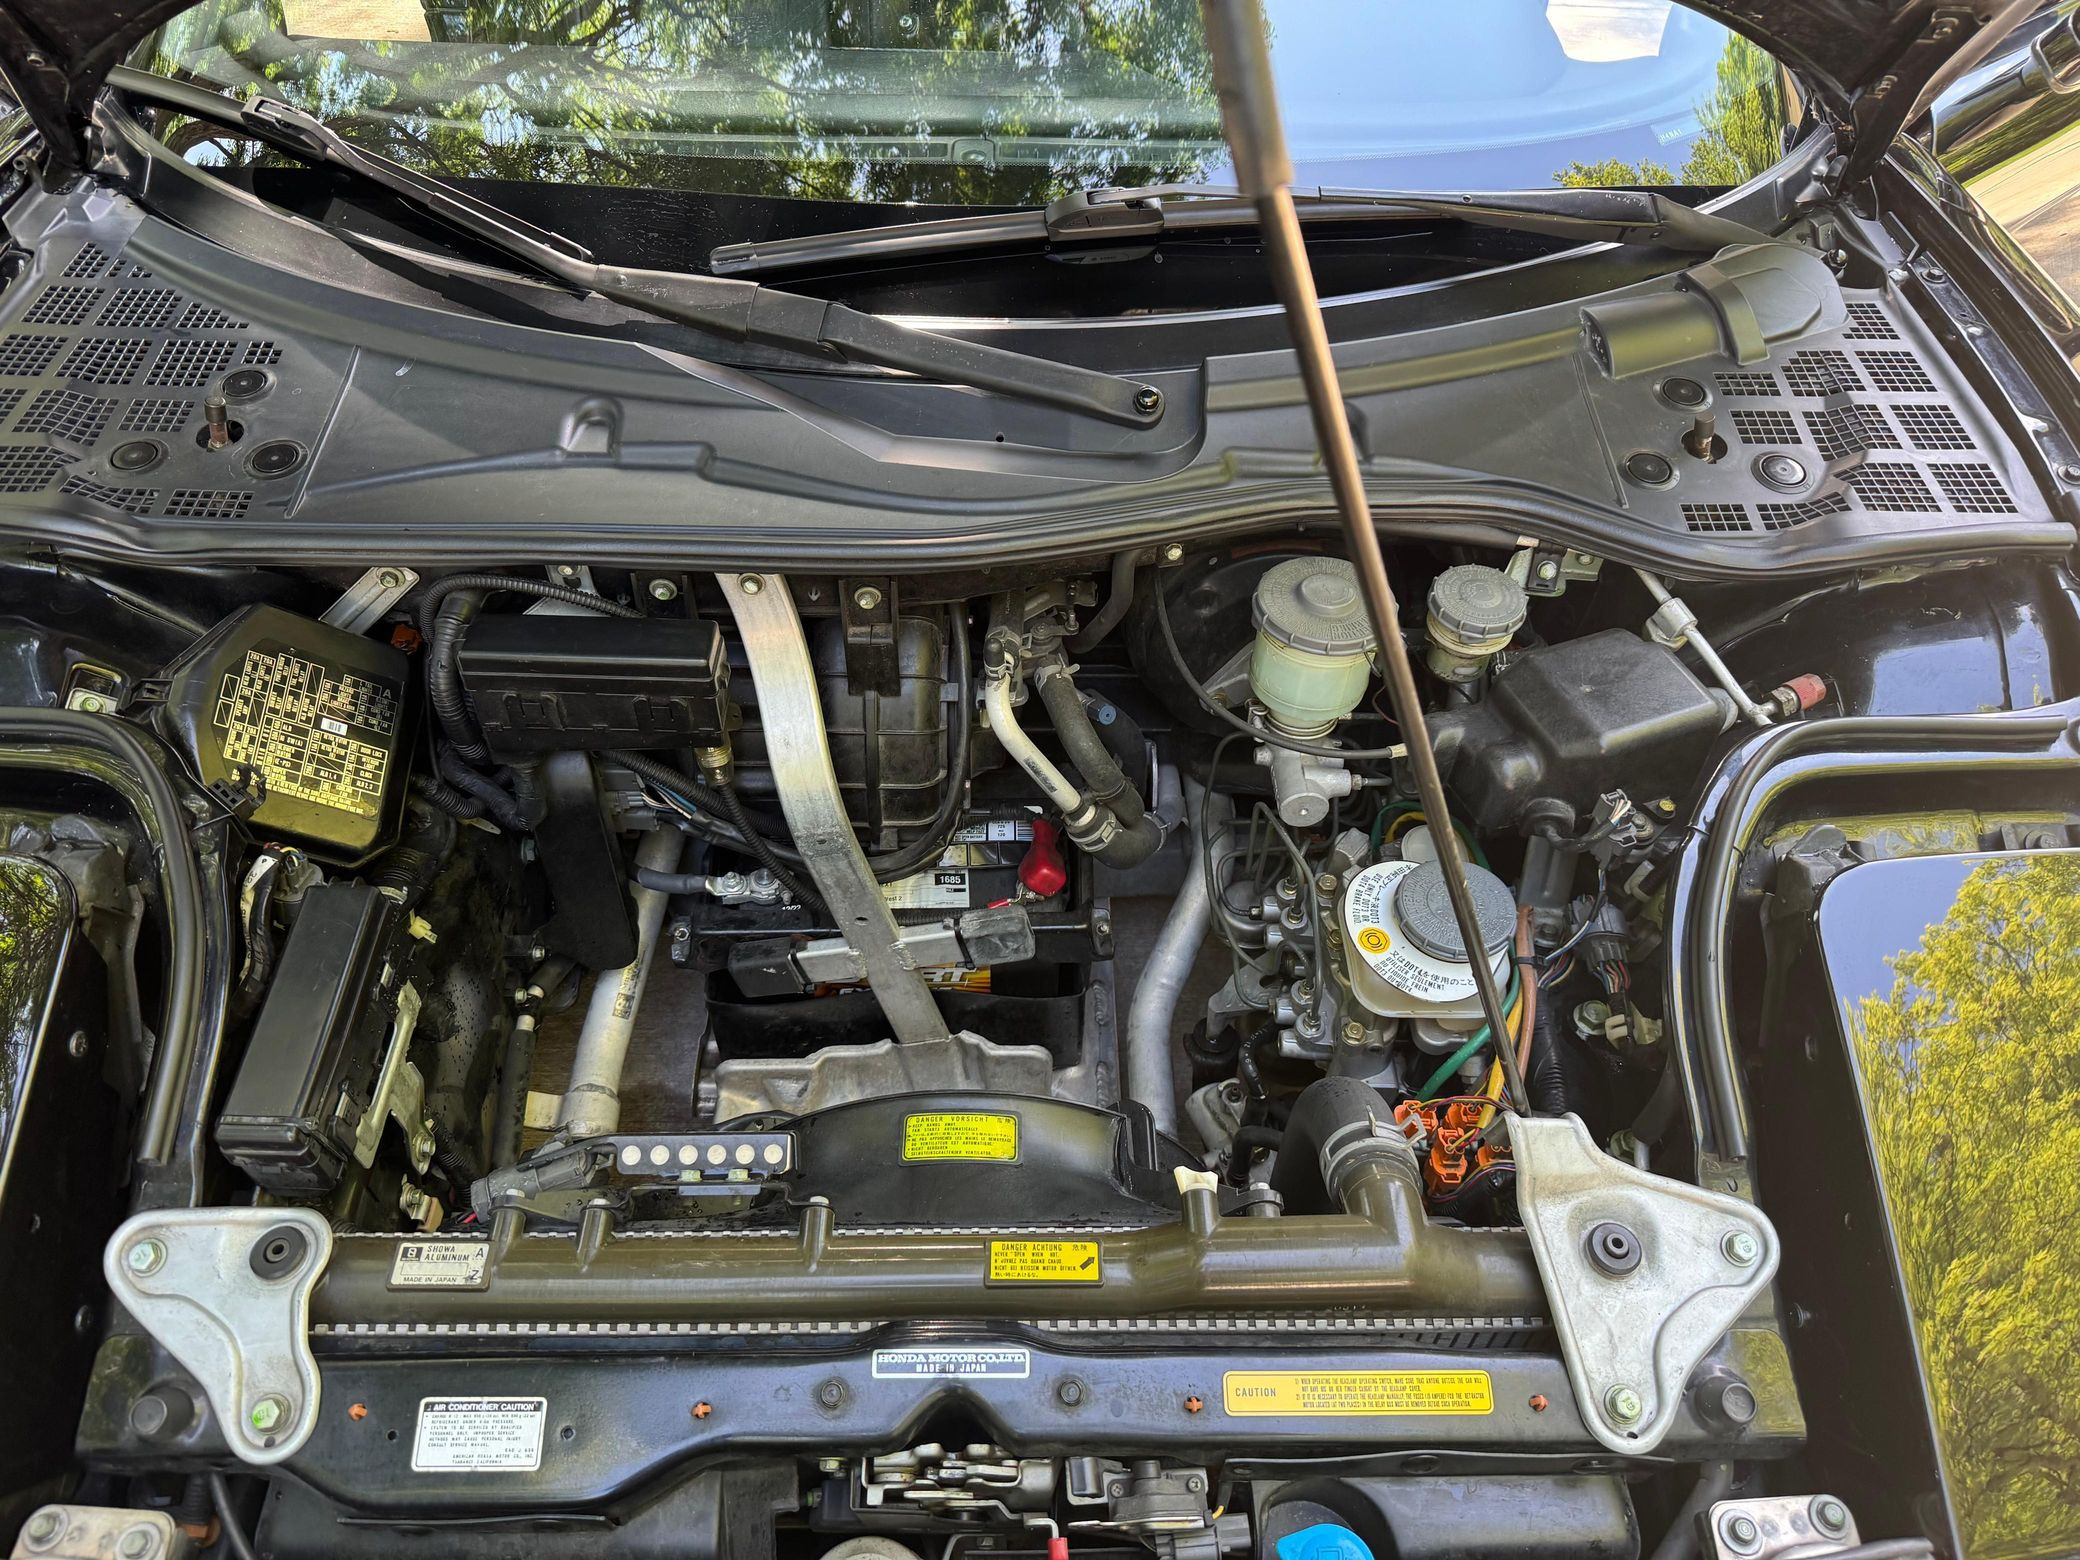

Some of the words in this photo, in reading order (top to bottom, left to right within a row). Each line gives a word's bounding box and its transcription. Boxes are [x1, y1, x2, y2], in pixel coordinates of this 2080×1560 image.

[382, 688, 393, 699] A
[476, 1248, 484, 1258] A
[878, 1354, 926, 1363] HONDA
[928, 1354, 977, 1363] MOTOR
[916, 1364, 940, 1372] MADE
[945, 1364, 955, 1372] IN
[960, 1364, 986, 1372] JAPAN
[1235, 1388, 1276, 1397] CAUTION
[433, 1403, 446, 1411] AIR
[448, 1403, 499, 1411] CONDITIONER
[501, 1403, 535, 1411] CAUTION
